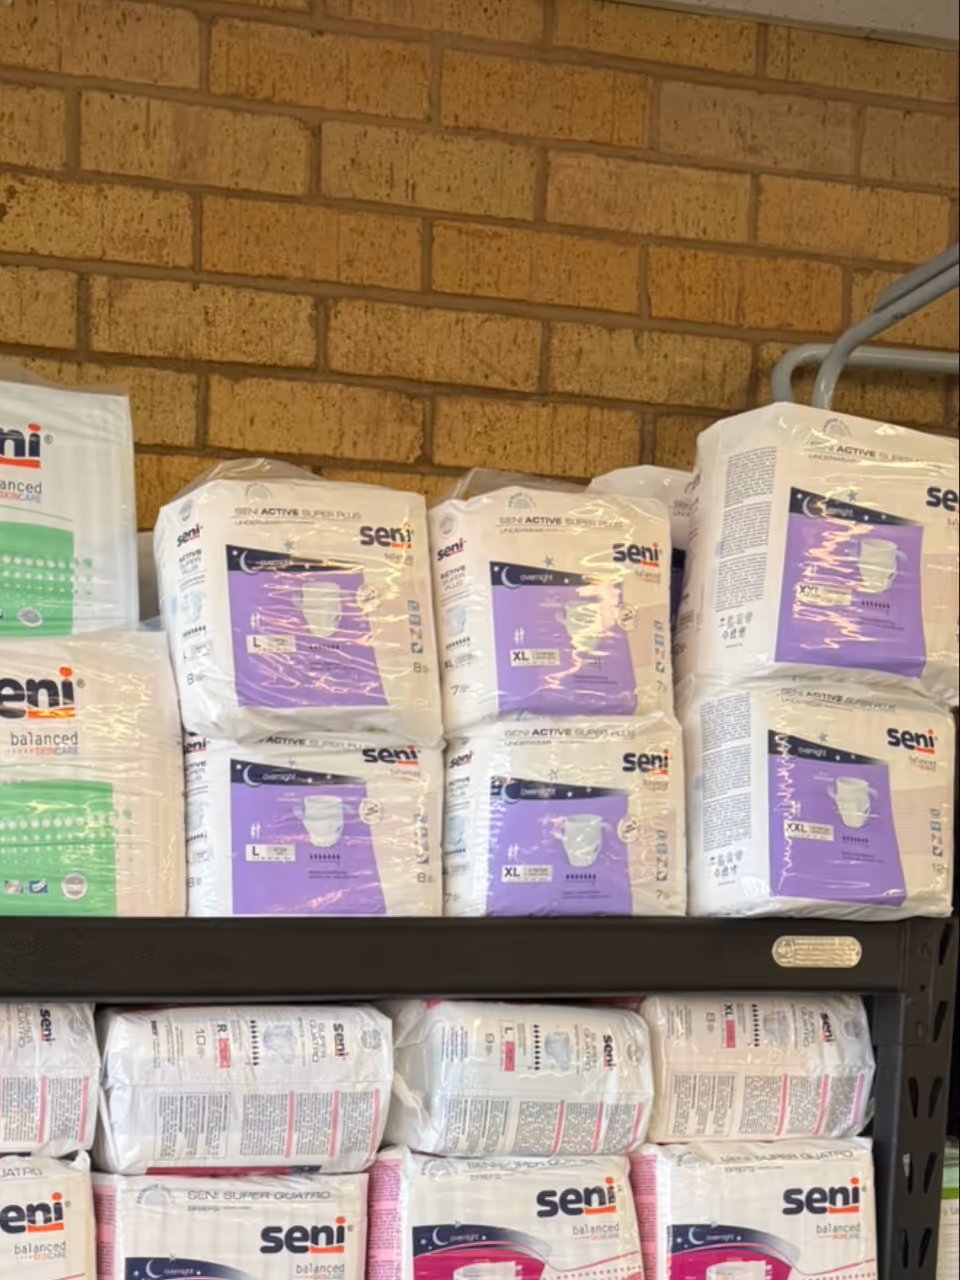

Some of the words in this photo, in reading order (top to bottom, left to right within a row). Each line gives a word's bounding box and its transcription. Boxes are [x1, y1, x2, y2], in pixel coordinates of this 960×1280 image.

[836, 444, 877, 459] ACTIVE
[926, 485, 959, 512] se
[260, 507, 300, 518] ACTIVE
[525, 515, 563, 526] ACTIVE
[359, 523, 413, 549] seni
[437, 537, 464, 561] seni
[612, 542, 660, 568] seni
[252, 638, 263, 649] L
[512, 650, 529, 663] XL
[10, 732, 79, 747] balanced
[532, 726, 572, 738] ACTIVE
[886, 728, 935, 754] seni
[362, 745, 419, 766] seni
[622, 749, 670, 775] seni
[251, 846, 261, 858] L
[503, 865, 521, 879] XL
[40, 1009, 54, 1047] seni
[217, 1024, 228, 1033] R
[820, 1012, 834, 1044] seni
[332, 1022, 346, 1060] seni
[603, 1034, 615, 1070] seni
[187, 1190, 219, 1201] SENI
[223, 1190, 269, 1201] SUPER
[536, 1176, 617, 1218] seni
[782, 1177, 860, 1216] seni
[259, 1216, 347, 1255] seni
[572, 1222, 620, 1236] balanced
[815, 1222, 861, 1236] balanced
[13, 1240, 67, 1256] balanced
[296, 1262, 346, 1276] balanced
